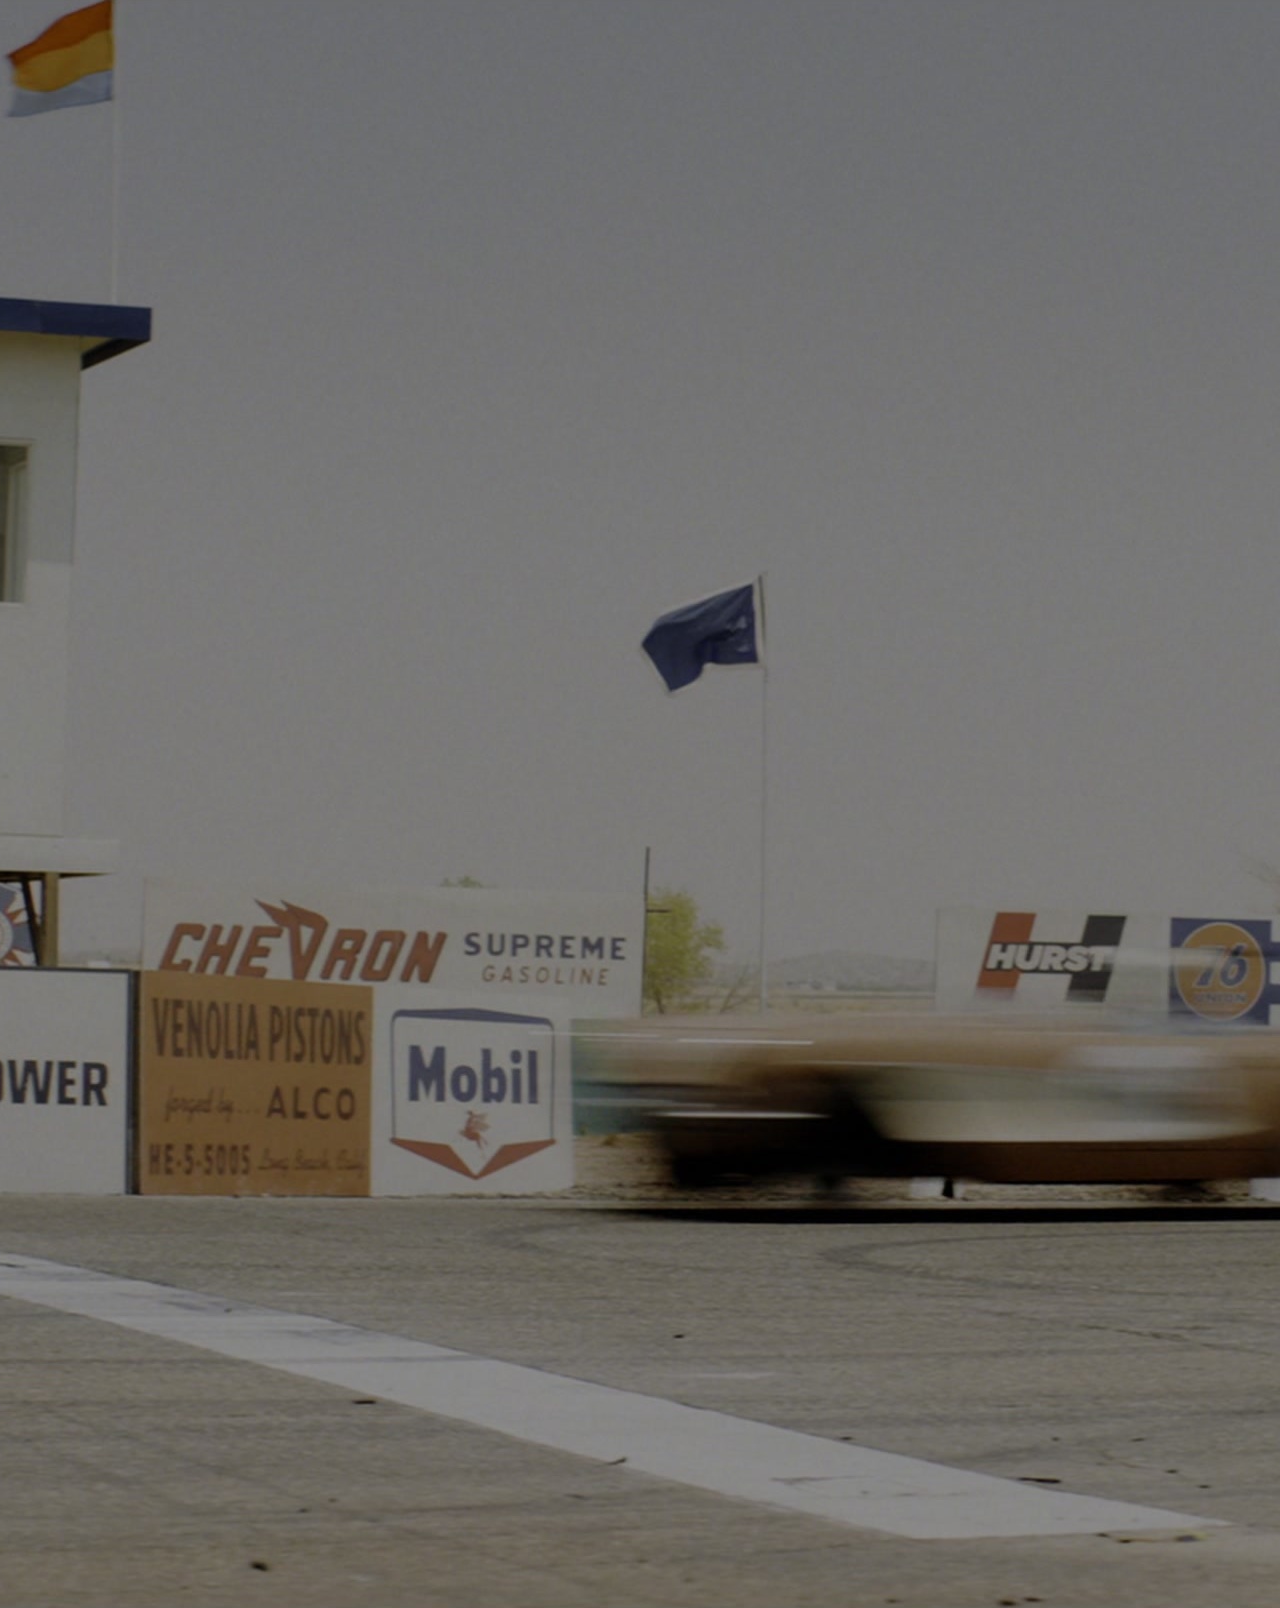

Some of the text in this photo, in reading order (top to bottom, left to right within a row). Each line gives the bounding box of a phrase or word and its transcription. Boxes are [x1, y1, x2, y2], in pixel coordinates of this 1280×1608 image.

[158, 899, 627, 983] CHEVRON SUPREME
[984, 943, 1108, 972] HURST
[482, 965, 609, 986] GASOLINE
[1191, 942, 1249, 988] 76
[1193, 991, 1248, 1004] UNION
[152, 998, 366, 1065] VENOLIA PISTONS
[409, 1045, 539, 1104] Mobil
[267, 1086, 356, 1120] ALCO
